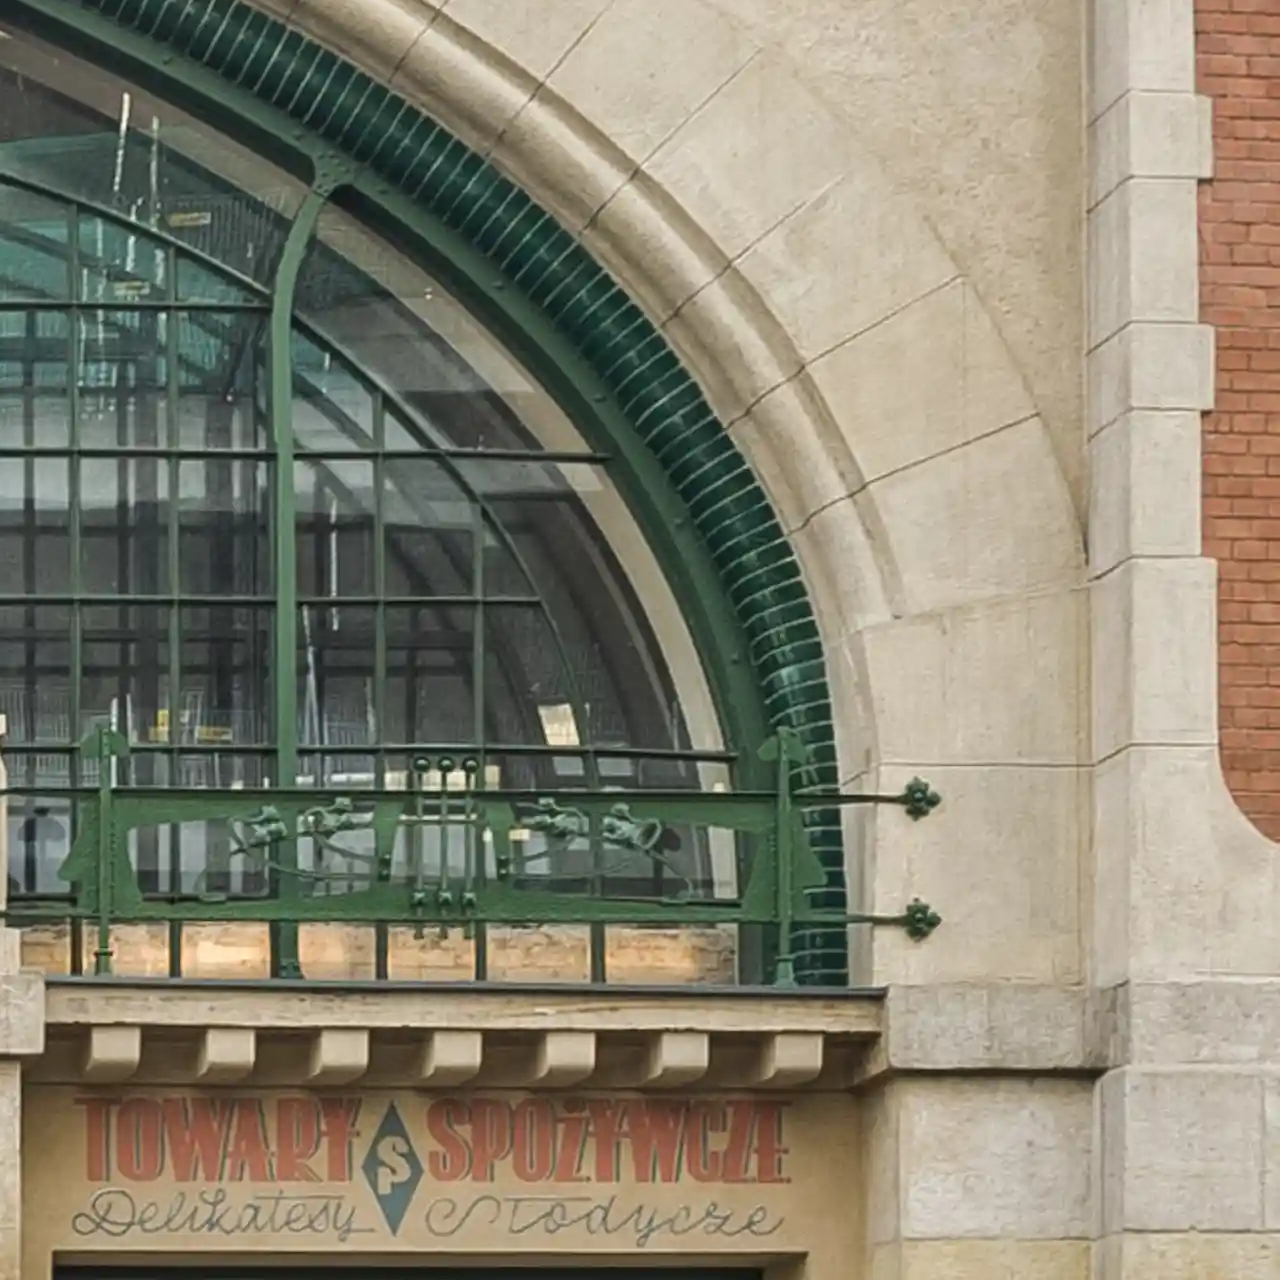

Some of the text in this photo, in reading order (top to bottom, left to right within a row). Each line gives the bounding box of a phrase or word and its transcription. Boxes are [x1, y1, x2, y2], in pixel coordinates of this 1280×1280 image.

[73, 1096, 793, 1184] TOWARY SPOŻYWCZE
[71, 1187, 377, 1243] Delikatesy
